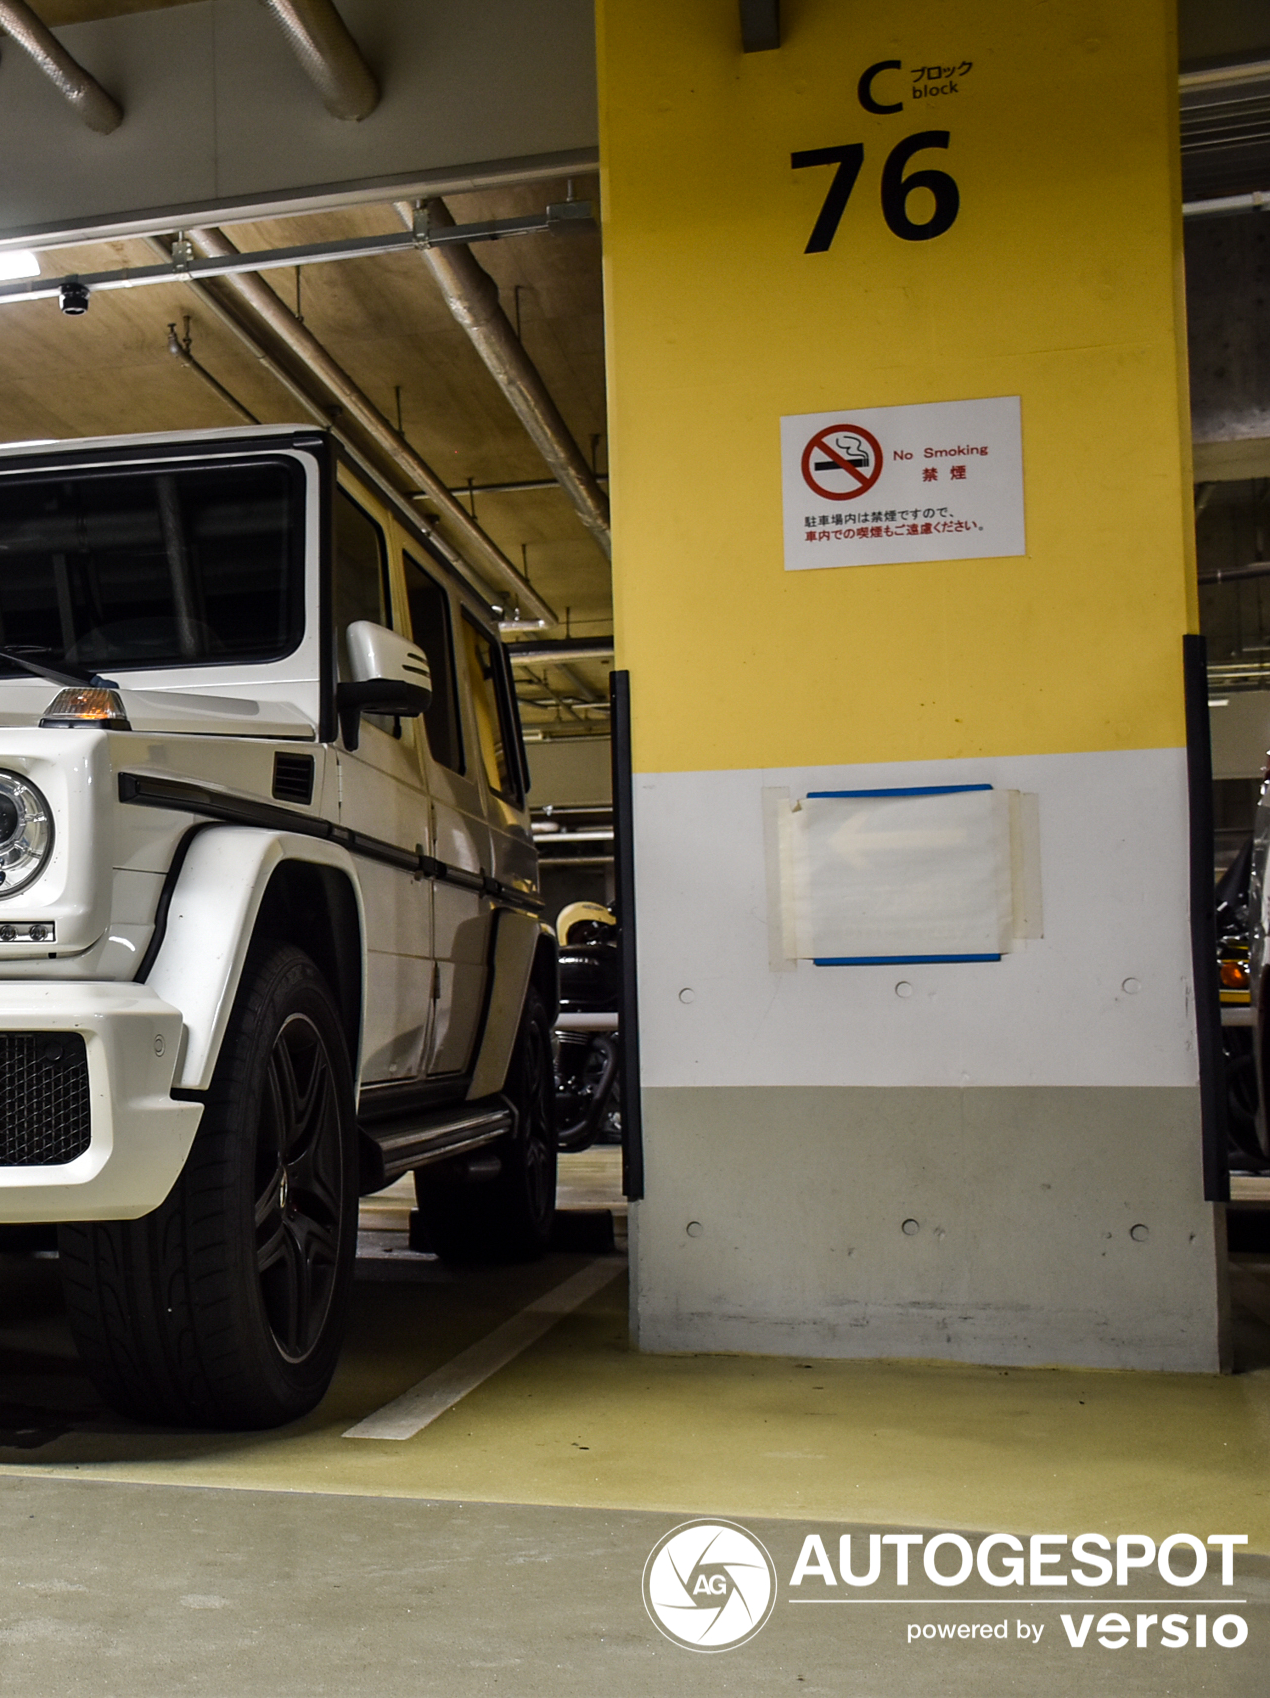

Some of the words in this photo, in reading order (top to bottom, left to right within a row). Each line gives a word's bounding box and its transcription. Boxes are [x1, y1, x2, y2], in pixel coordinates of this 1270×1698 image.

[910, 61, 973, 83] ブロック
[857, 60, 903, 115] C
[912, 80, 959, 99] block
[790, 130, 961, 254] 76
[893, 450, 913, 461] No
[923, 444, 989, 459] Smoking
[804, 507, 954, 528] 駐車場内は禁煙ですので、
